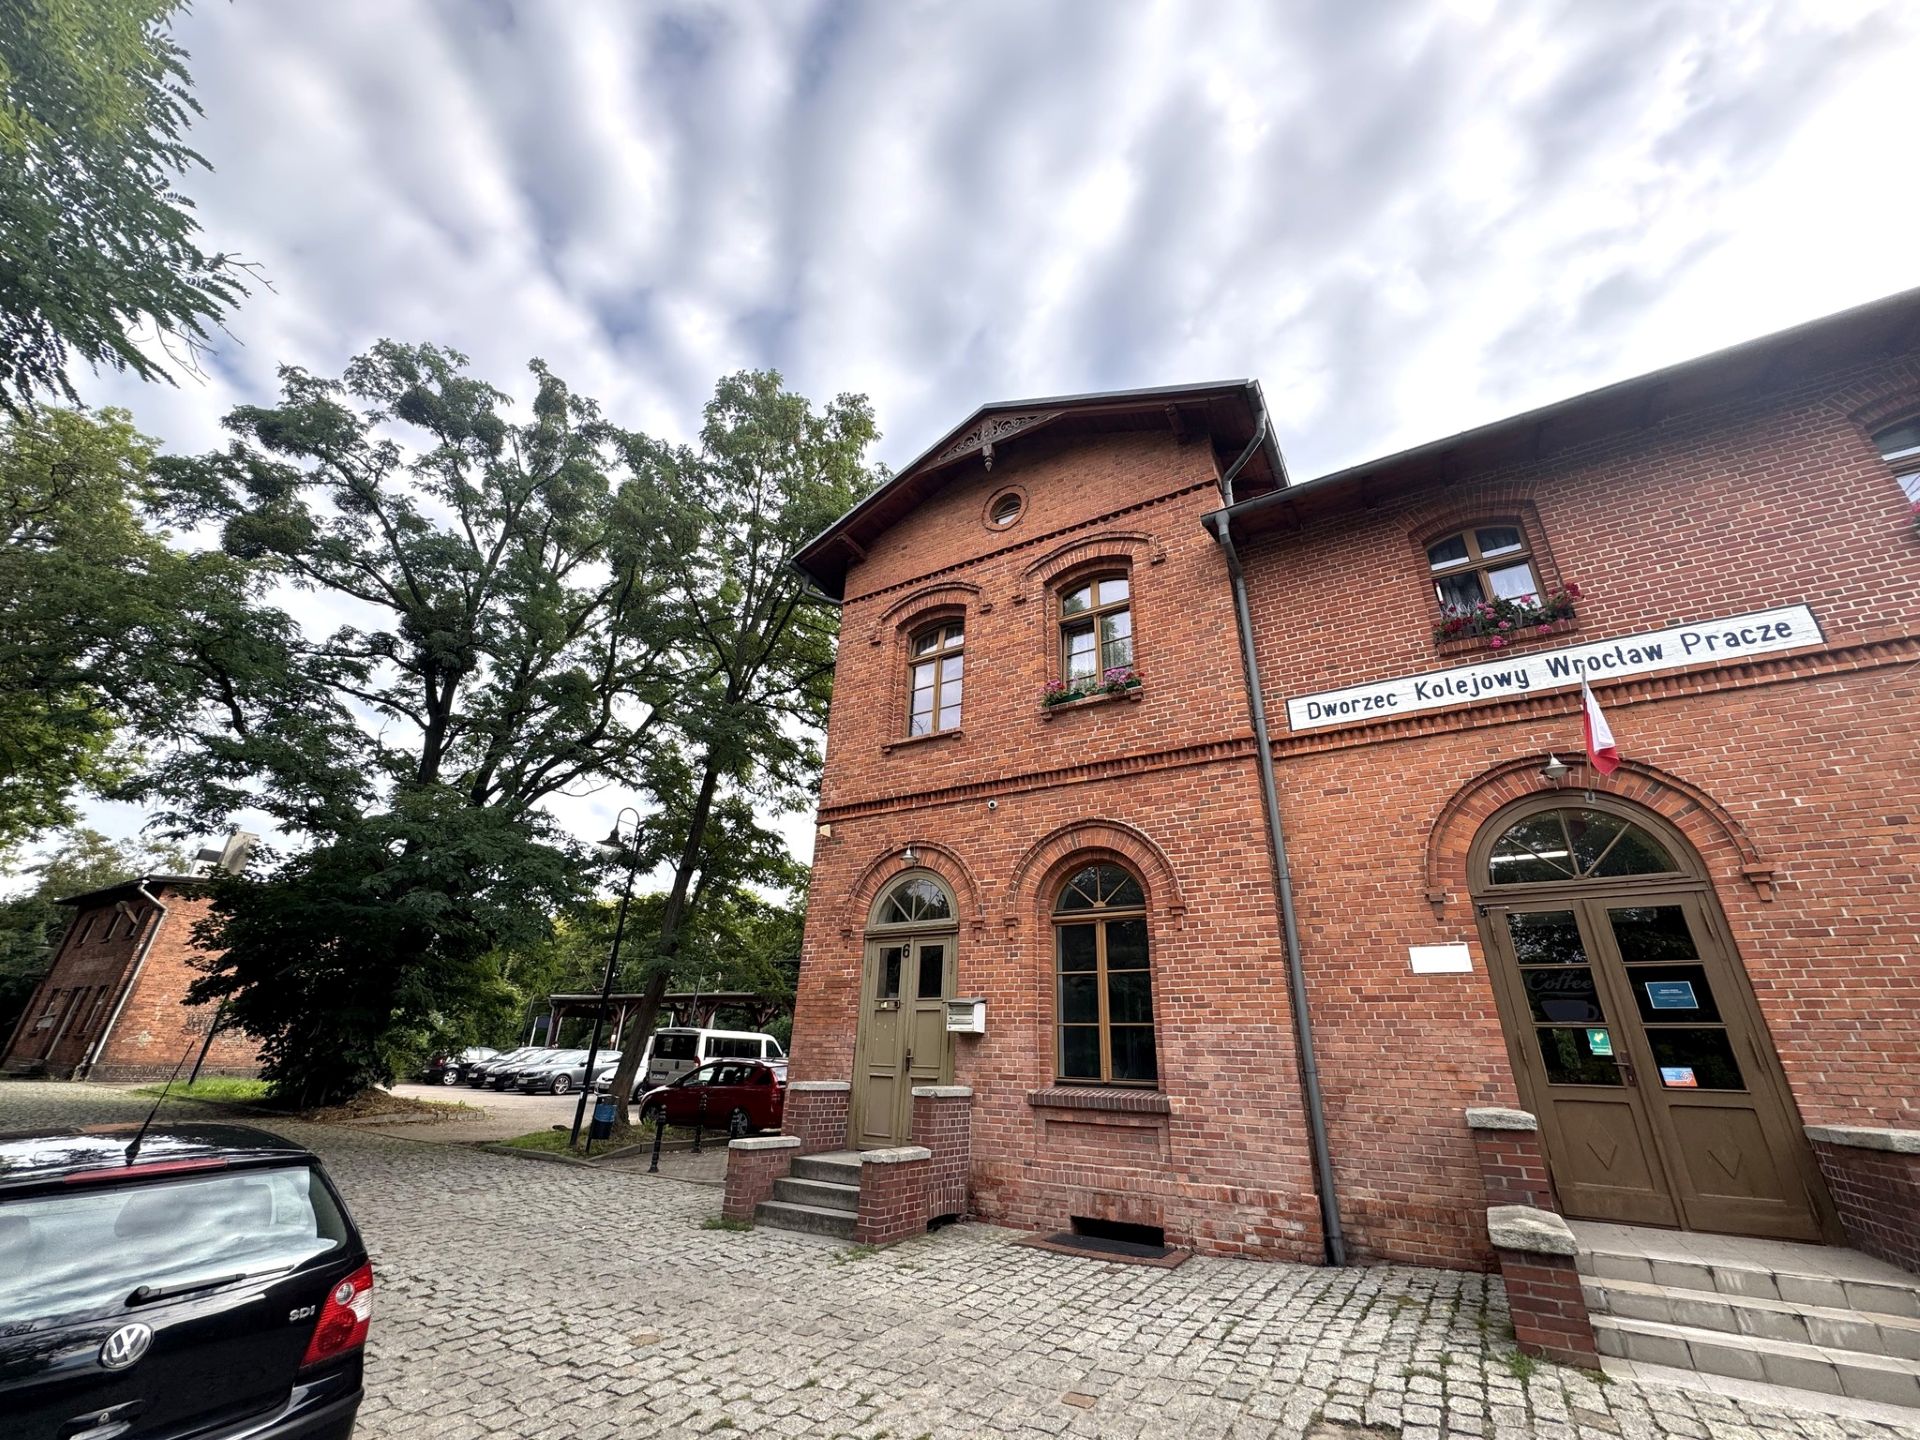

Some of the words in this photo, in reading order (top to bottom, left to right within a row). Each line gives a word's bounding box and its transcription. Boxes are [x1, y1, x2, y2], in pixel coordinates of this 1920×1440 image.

[1307, 692, 1398, 720] Dworzec
[1414, 668, 1530, 698] Kolejowy
[1545, 644, 1663, 678] Wrocław
[1680, 621, 1793, 655] Pracze
[902, 943, 910, 958] 6
[1527, 969, 1593, 991] Coffee
[288, 1305, 315, 1322] SDI
